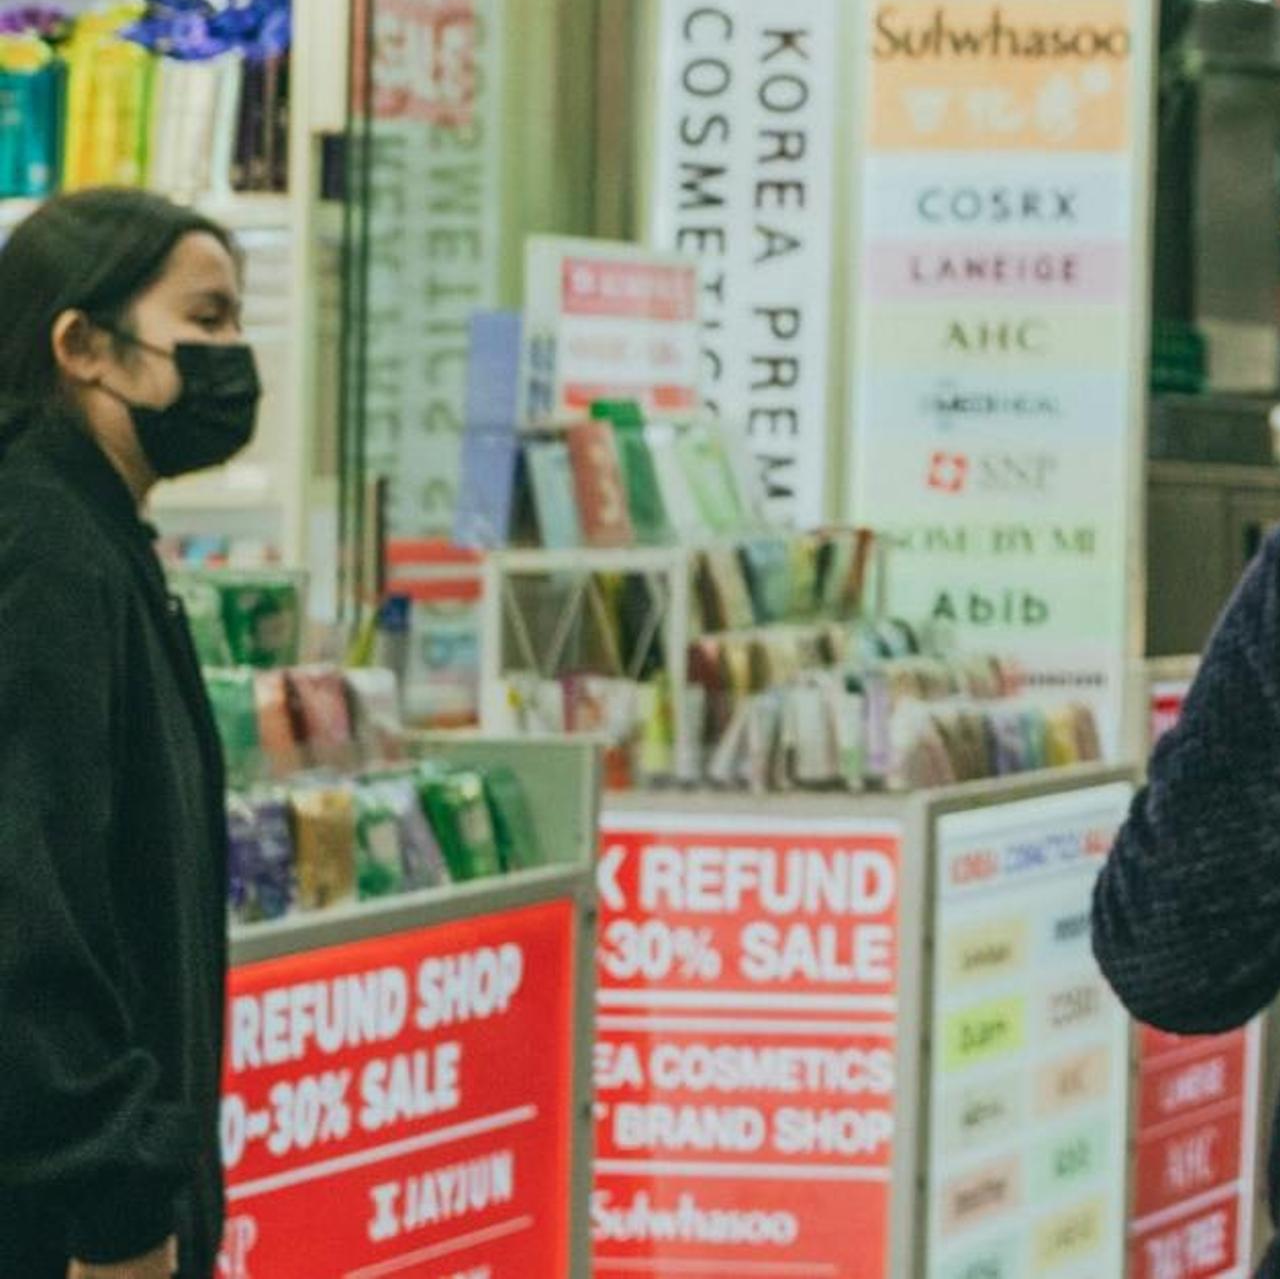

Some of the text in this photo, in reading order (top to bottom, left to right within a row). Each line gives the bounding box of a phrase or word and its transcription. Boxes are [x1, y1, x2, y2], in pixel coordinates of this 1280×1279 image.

[874, 4, 1129, 61] Sulwhasoo
[754, 27, 809, 264] KOREA
[917, 187, 1077, 223] COSRX
[909, 254, 1079, 284] LANEIGE
[932, 592, 1050, 625] Abib
[639, 846, 894, 917] REFUND
[738, 923, 893, 984] SALE
[230, 943, 523, 1074] REFUND SHOP
[360, 1041, 463, 1130] SALE
[650, 1042, 896, 1095] COSMETICS
[614, 1102, 895, 1156] BRAND SHOP
